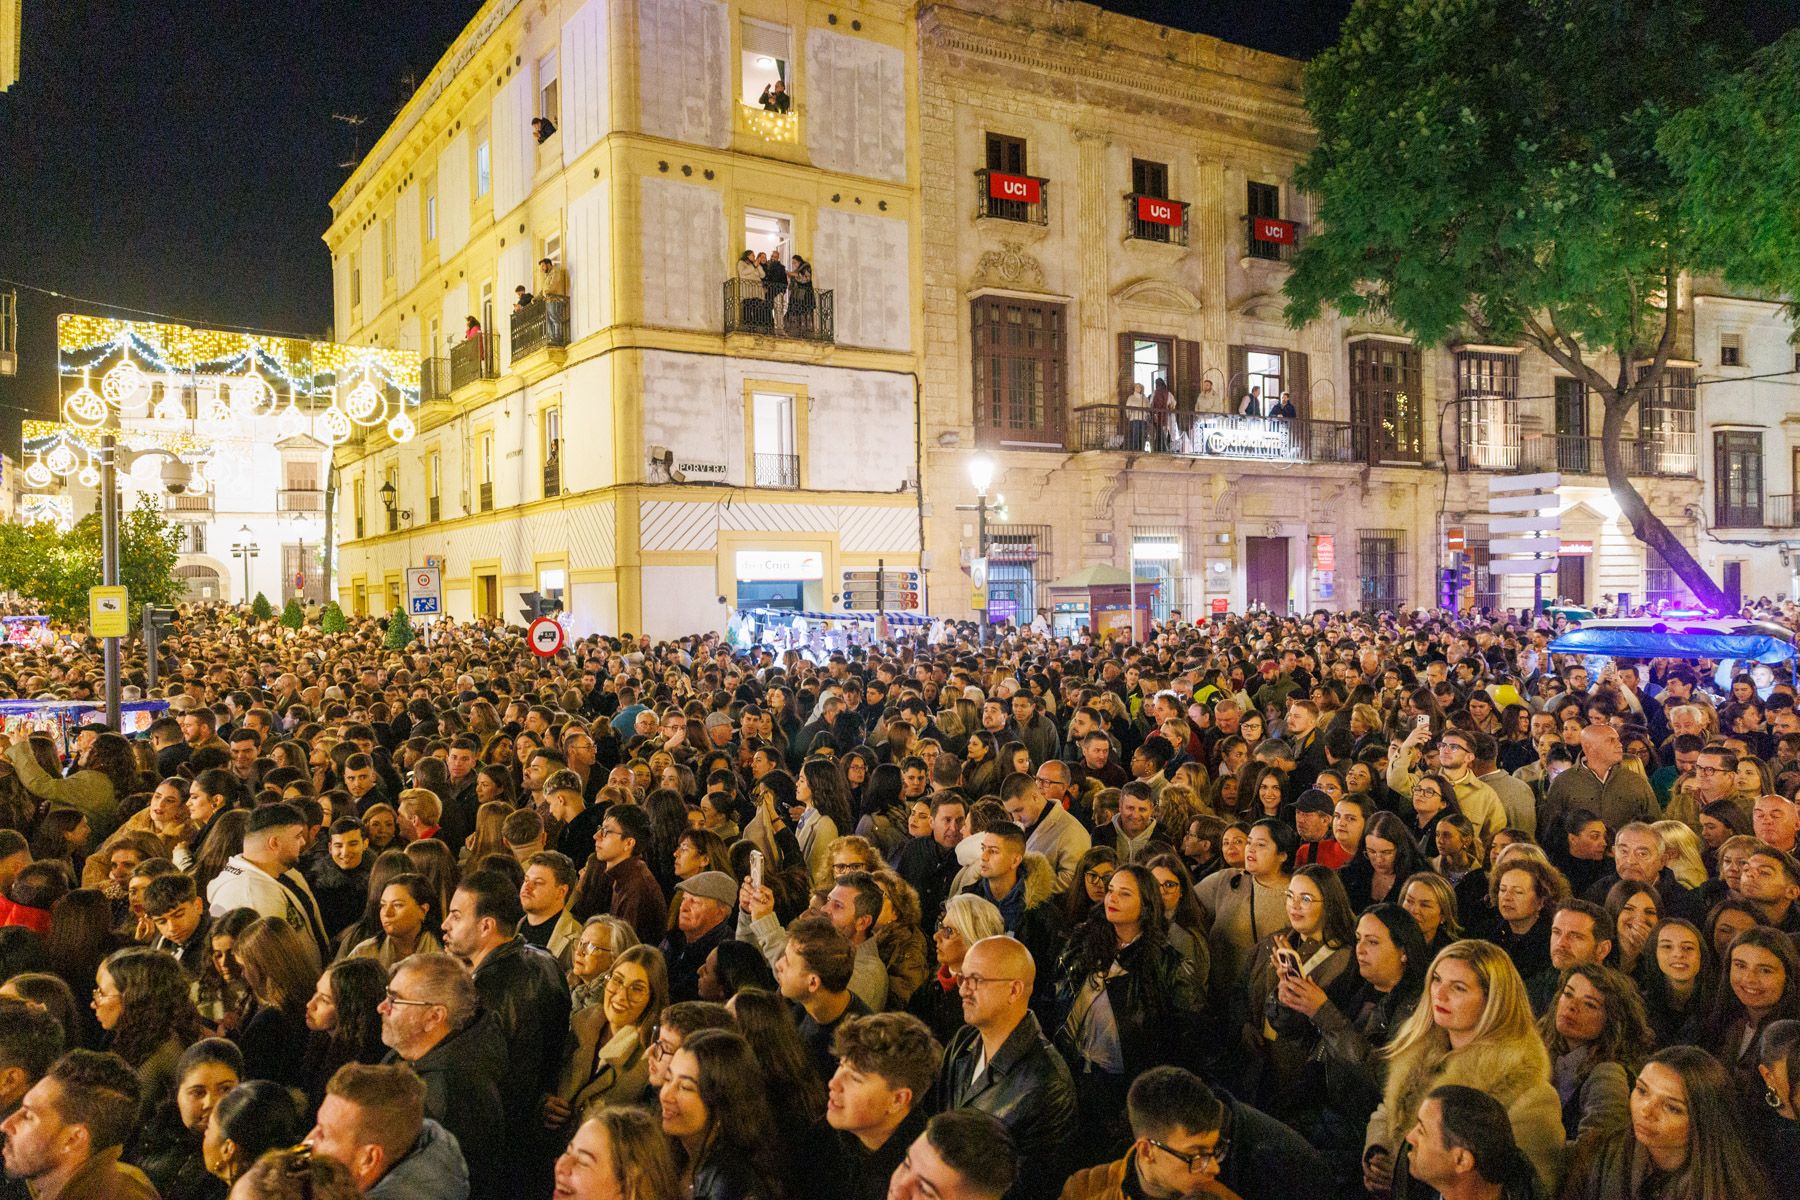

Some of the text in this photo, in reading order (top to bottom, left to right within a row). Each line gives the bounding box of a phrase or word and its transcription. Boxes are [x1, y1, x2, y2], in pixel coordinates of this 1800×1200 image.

[1004, 181, 1026, 196] UCI
[1151, 205, 1170, 219] UCI
[1265, 226, 1283, 238] UCI
[679, 464, 727, 472] PORVERA
